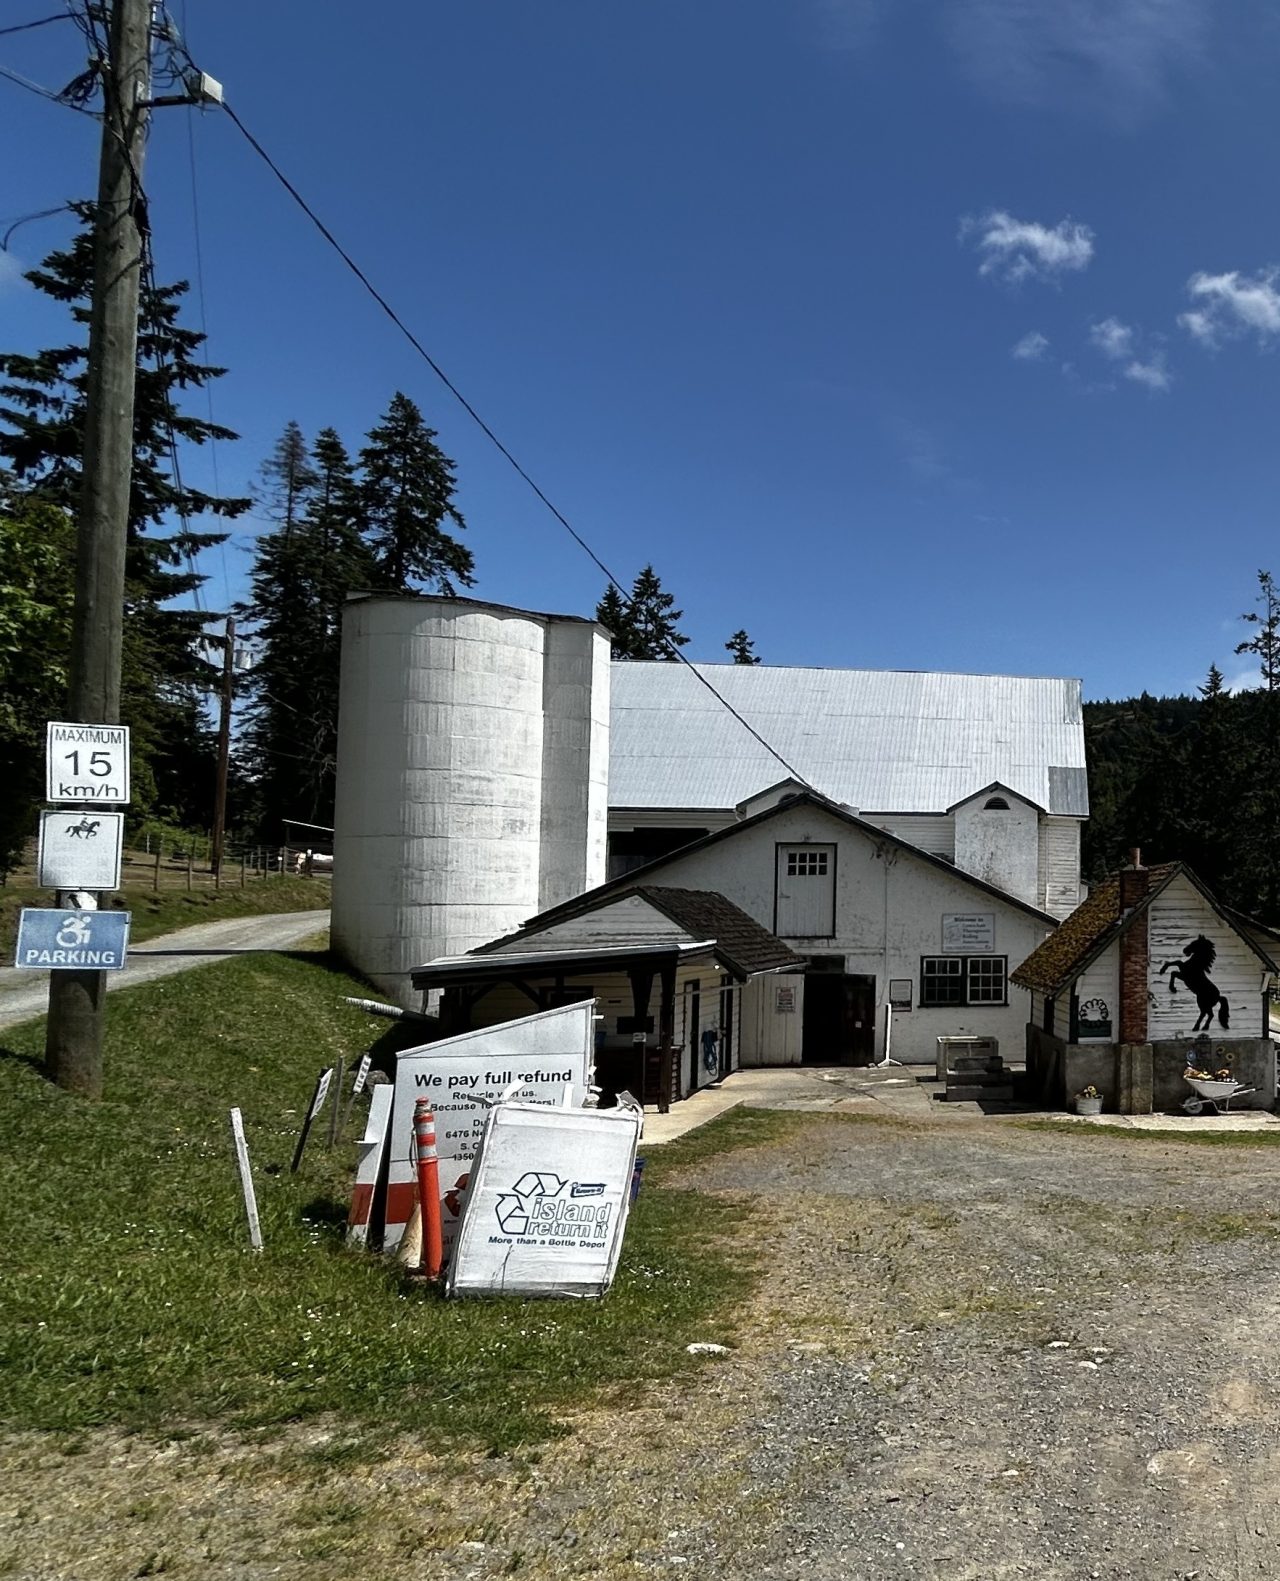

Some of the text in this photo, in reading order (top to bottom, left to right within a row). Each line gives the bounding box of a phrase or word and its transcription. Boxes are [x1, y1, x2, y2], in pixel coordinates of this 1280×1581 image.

[55, 728, 122, 744] MAXIMUM
[64, 750, 112, 776] 15
[59, 783, 118, 797] km/h
[26, 950, 115, 964] PARKING
[415, 1069, 572, 1089] We pay full refund
[452, 1091, 494, 1100] Rele
[431, 1101, 476, 1112] Because
[445, 1130, 469, 1139] 6476
[531, 1197, 612, 1223] island
[528, 1220, 609, 1239] return it
[488, 1236, 512, 1244] More
[548, 1239, 576, 1247] Bottle
[579, 1240, 605, 1248] Depot
